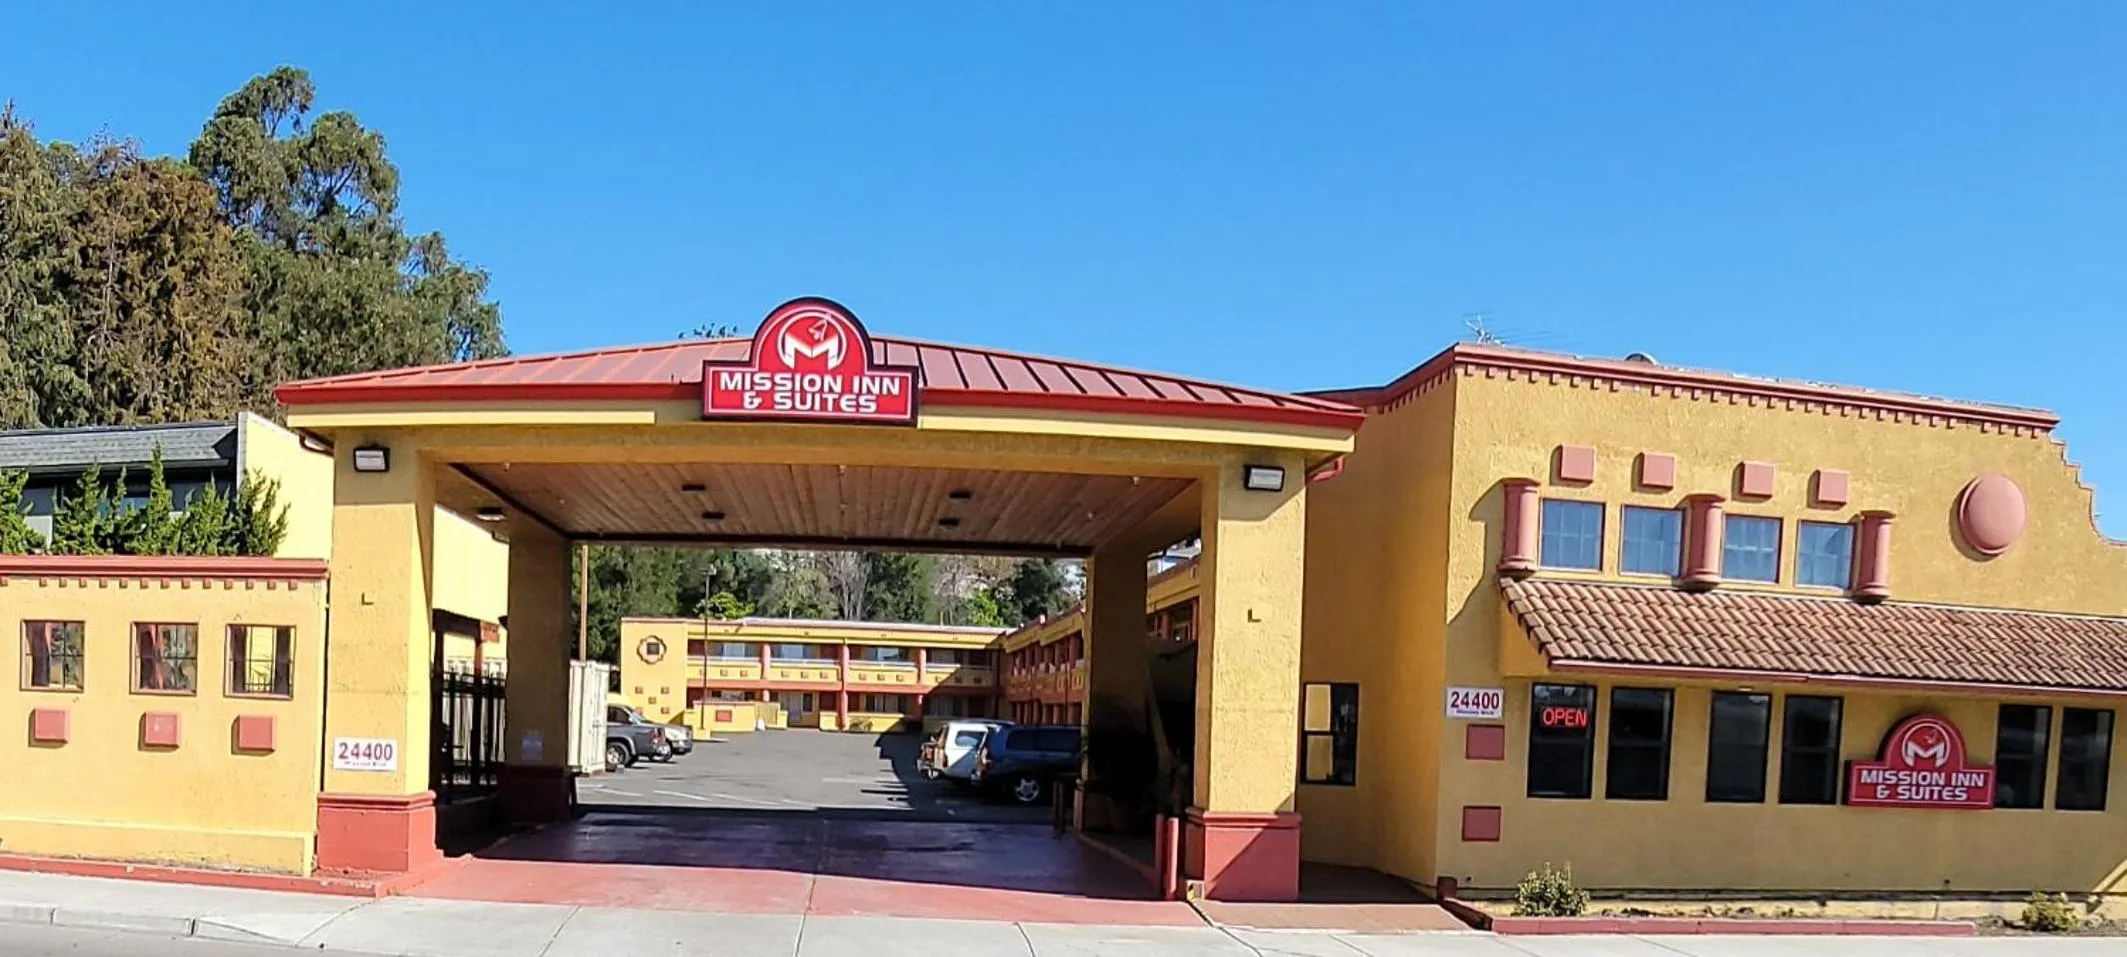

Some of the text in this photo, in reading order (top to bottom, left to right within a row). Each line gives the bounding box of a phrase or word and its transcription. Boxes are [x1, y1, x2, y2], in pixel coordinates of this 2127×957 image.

[719, 372, 900, 396] MISSION INN
[743, 392, 878, 413] & SUITES
[1450, 691, 1500, 710] 24400
[1542, 708, 1588, 727] OPEN
[338, 742, 393, 761] 24400
[1860, 770, 1985, 787] MISSION INN
[1876, 785, 1968, 801] & SUITES
